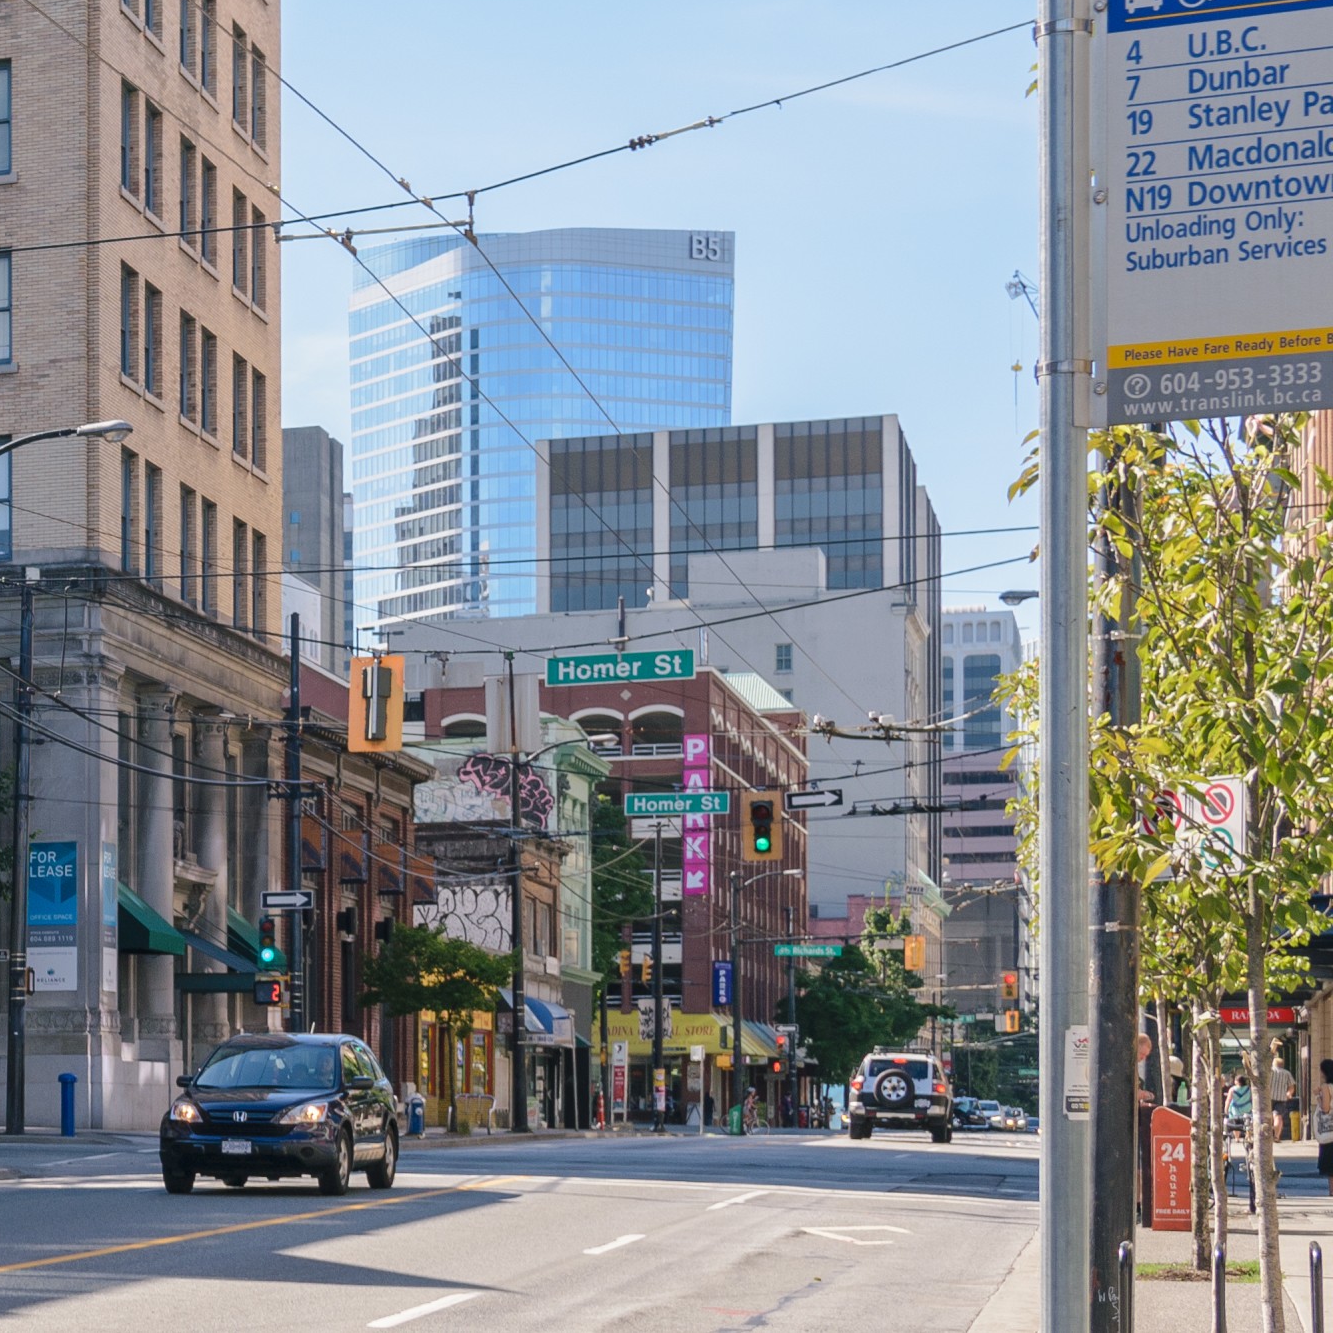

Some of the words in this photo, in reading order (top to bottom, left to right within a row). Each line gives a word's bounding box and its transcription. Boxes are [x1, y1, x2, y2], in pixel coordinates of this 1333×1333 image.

[1126, 40, 1143, 65] 4
[1188, 26, 1267, 58] U.B.C.
[1126, 75, 1141, 101] 7
[1188, 60, 1290, 94] Dunbar
[1126, 109, 1153, 136] 19
[1188, 95, 1291, 129] Stanley
[1126, 150, 1157, 178] 22
[1125, 184, 1172, 213] N19
[1188, 173, 1333, 207] Downtow
[1125, 214, 1236, 244] Unloading
[1245, 206, 1304, 234] Only:
[690, 234, 721, 261] B5
[1125, 244, 1229, 272] Suburban
[1238, 235, 1327, 262] Services
[1124, 349, 1163, 361] Please
[1167, 346, 1199, 358] Have
[1204, 343, 1230, 355] Fare
[1235, 338, 1274, 352] Ready
[1279, 335, 1321, 349] Before
[1160, 362, 1322, 395] 604-953-3333
[1124, 387, 1322, 416] www.translink.bc.ca
[558, 660, 642, 681] Homer
[654, 654, 682, 676] St
[634, 797, 693, 812] Homer
[700, 796, 721, 811] St
[29, 851, 56, 864] FOR
[29, 864, 73, 878] LEASE
[793, 947, 824, 955] Richards
[272, 984, 280, 1001] 2
[1231, 1010, 1280, 1020] RADA
[599, 1025, 633, 1036] ADINA
[684, 1025, 715, 1036] STORE
[1161, 1142, 1185, 1162] 24
